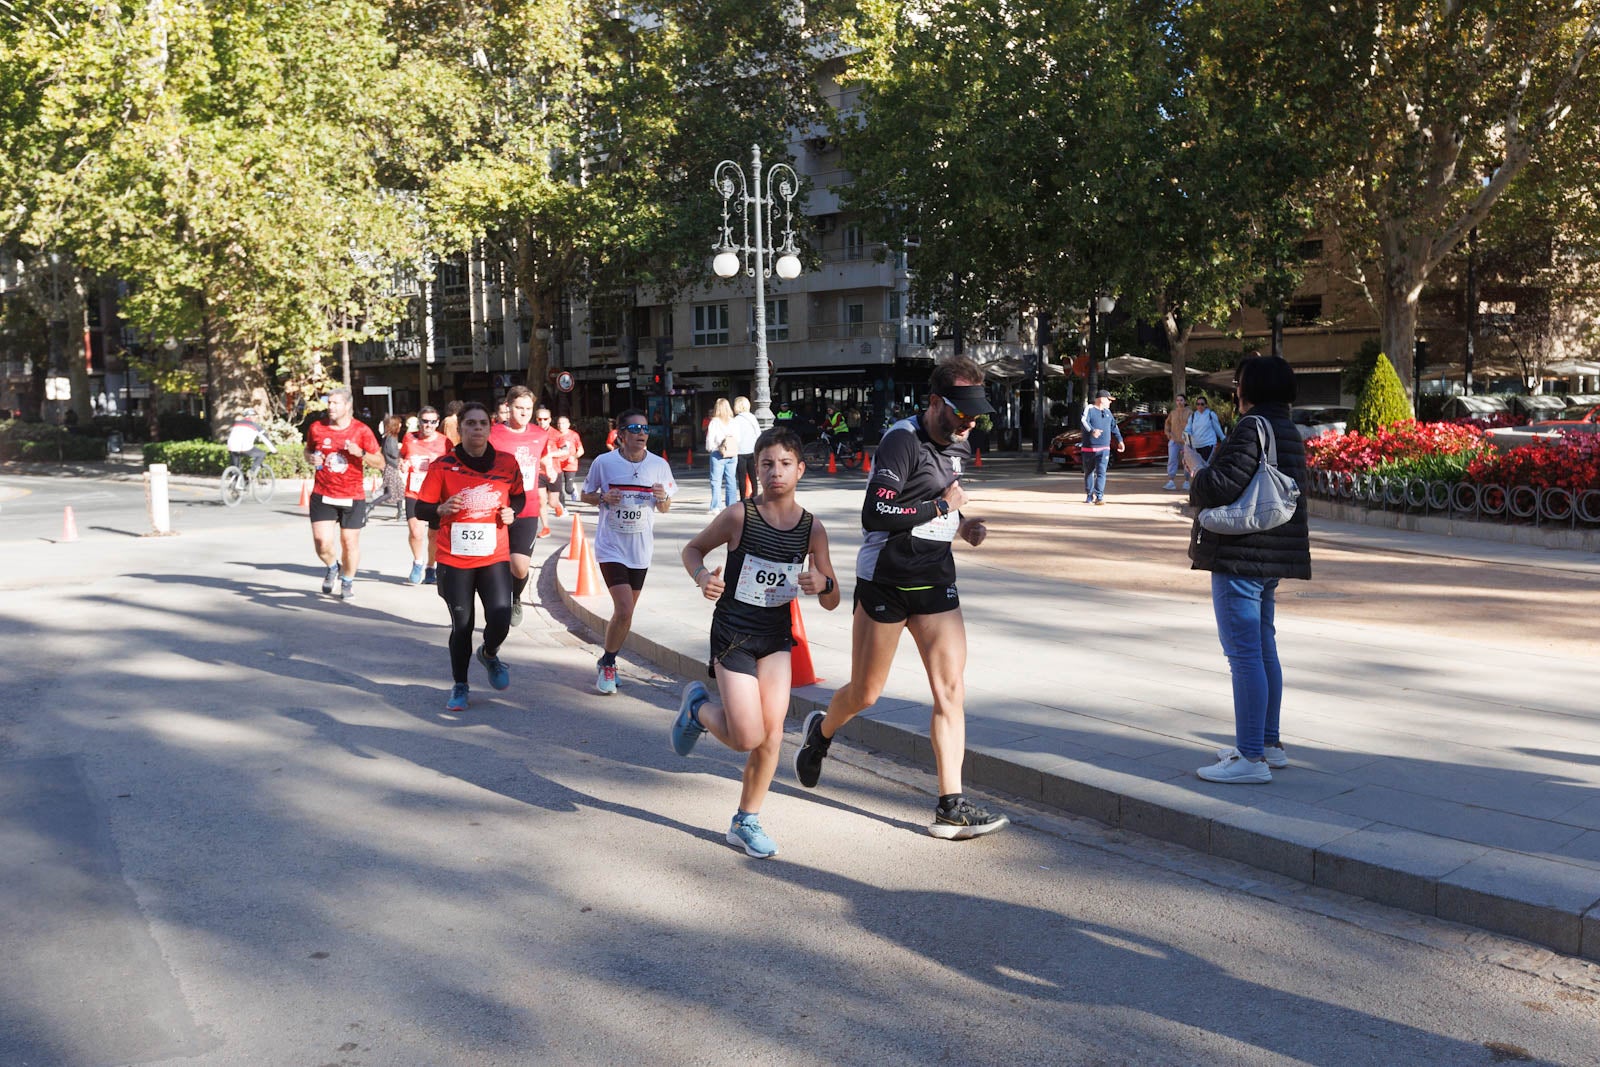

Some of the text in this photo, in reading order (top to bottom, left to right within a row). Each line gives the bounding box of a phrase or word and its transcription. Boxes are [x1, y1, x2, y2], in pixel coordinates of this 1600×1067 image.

[615, 509, 642, 520] 1309
[461, 530, 485, 541] 532
[755, 569, 787, 587] 692
